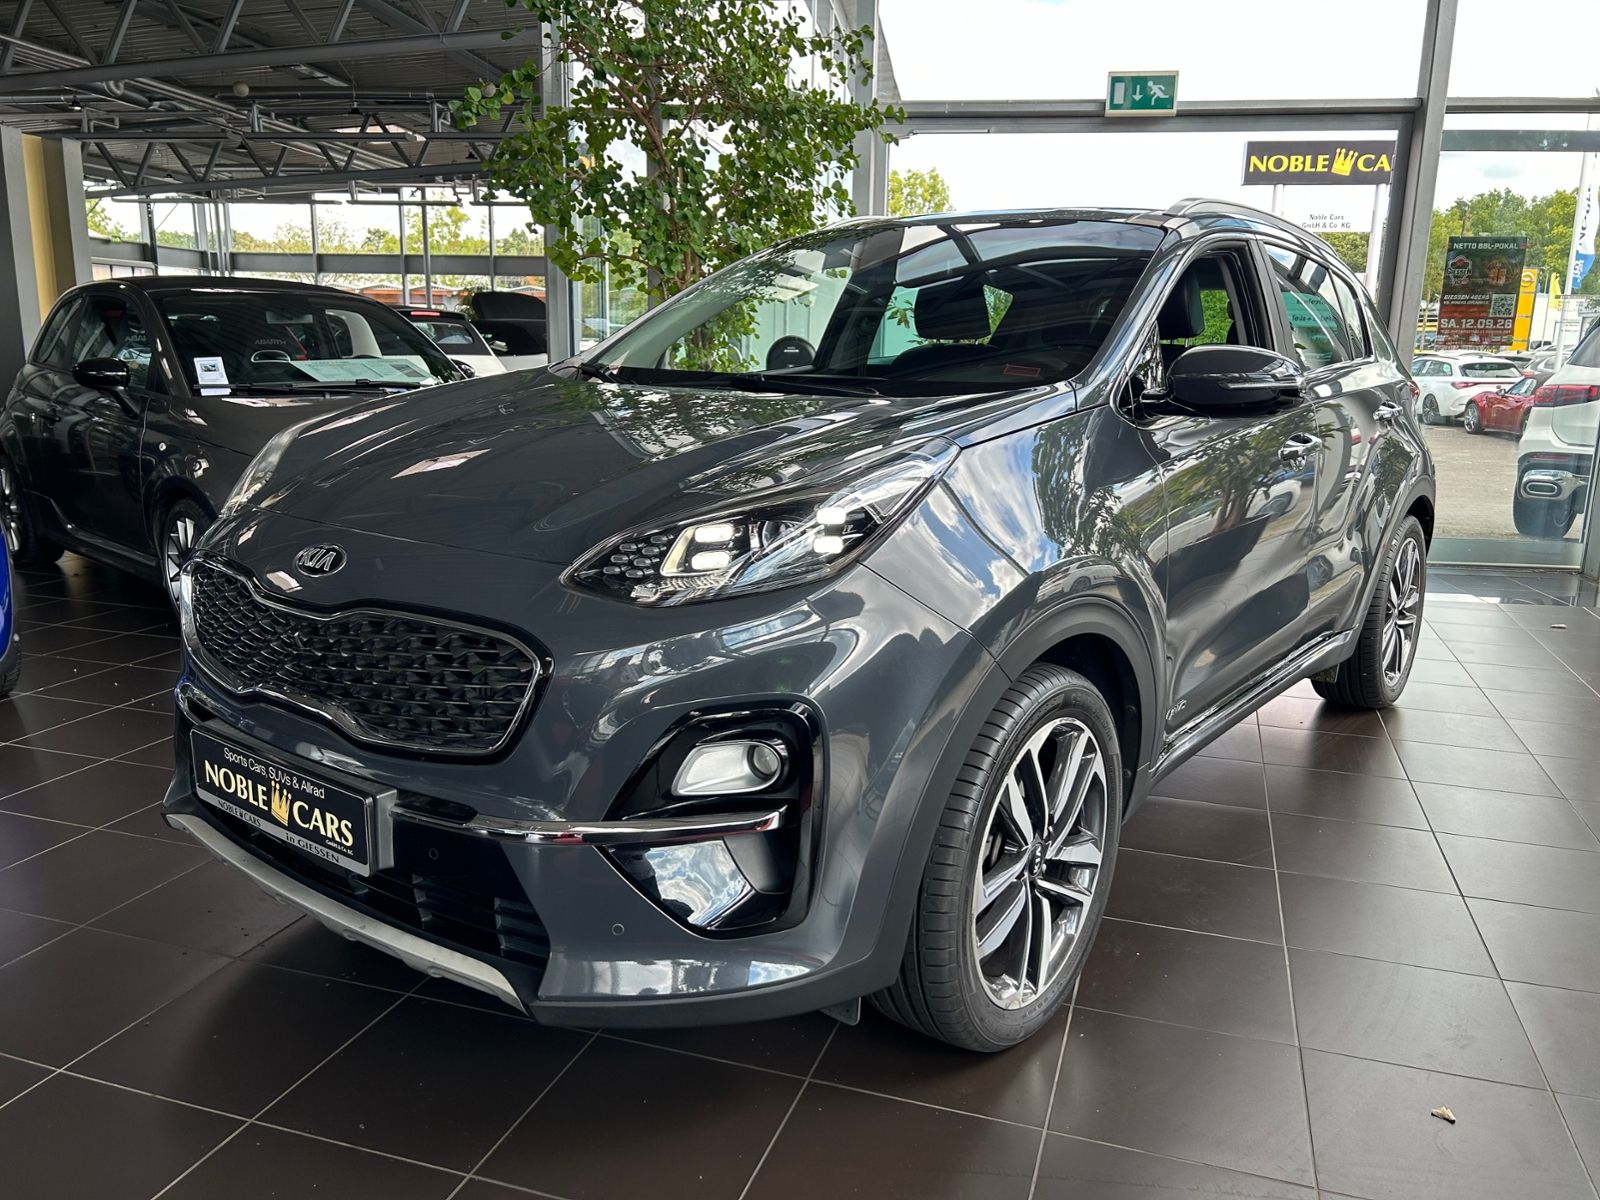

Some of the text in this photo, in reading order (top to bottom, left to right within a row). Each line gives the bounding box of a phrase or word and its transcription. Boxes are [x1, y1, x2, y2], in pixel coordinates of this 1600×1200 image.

[1249, 154, 1330, 172] NOBLE
[1309, 213, 1345, 221] Noble Cars
[1340, 221, 1351, 229] KG
[1453, 242, 1519, 250] NETTO BBL-POKAL
[1440, 318, 1512, 329] SA. 12.09.26
[298, 547, 337, 571] KIA
[224, 747, 325, 799] Sports Cars, SUVs & Allrad
[204, 759, 354, 847] NOBLE CARS
[218, 799, 262, 828] NOBLE CARS
[285, 832, 340, 863] in GIESSEN
